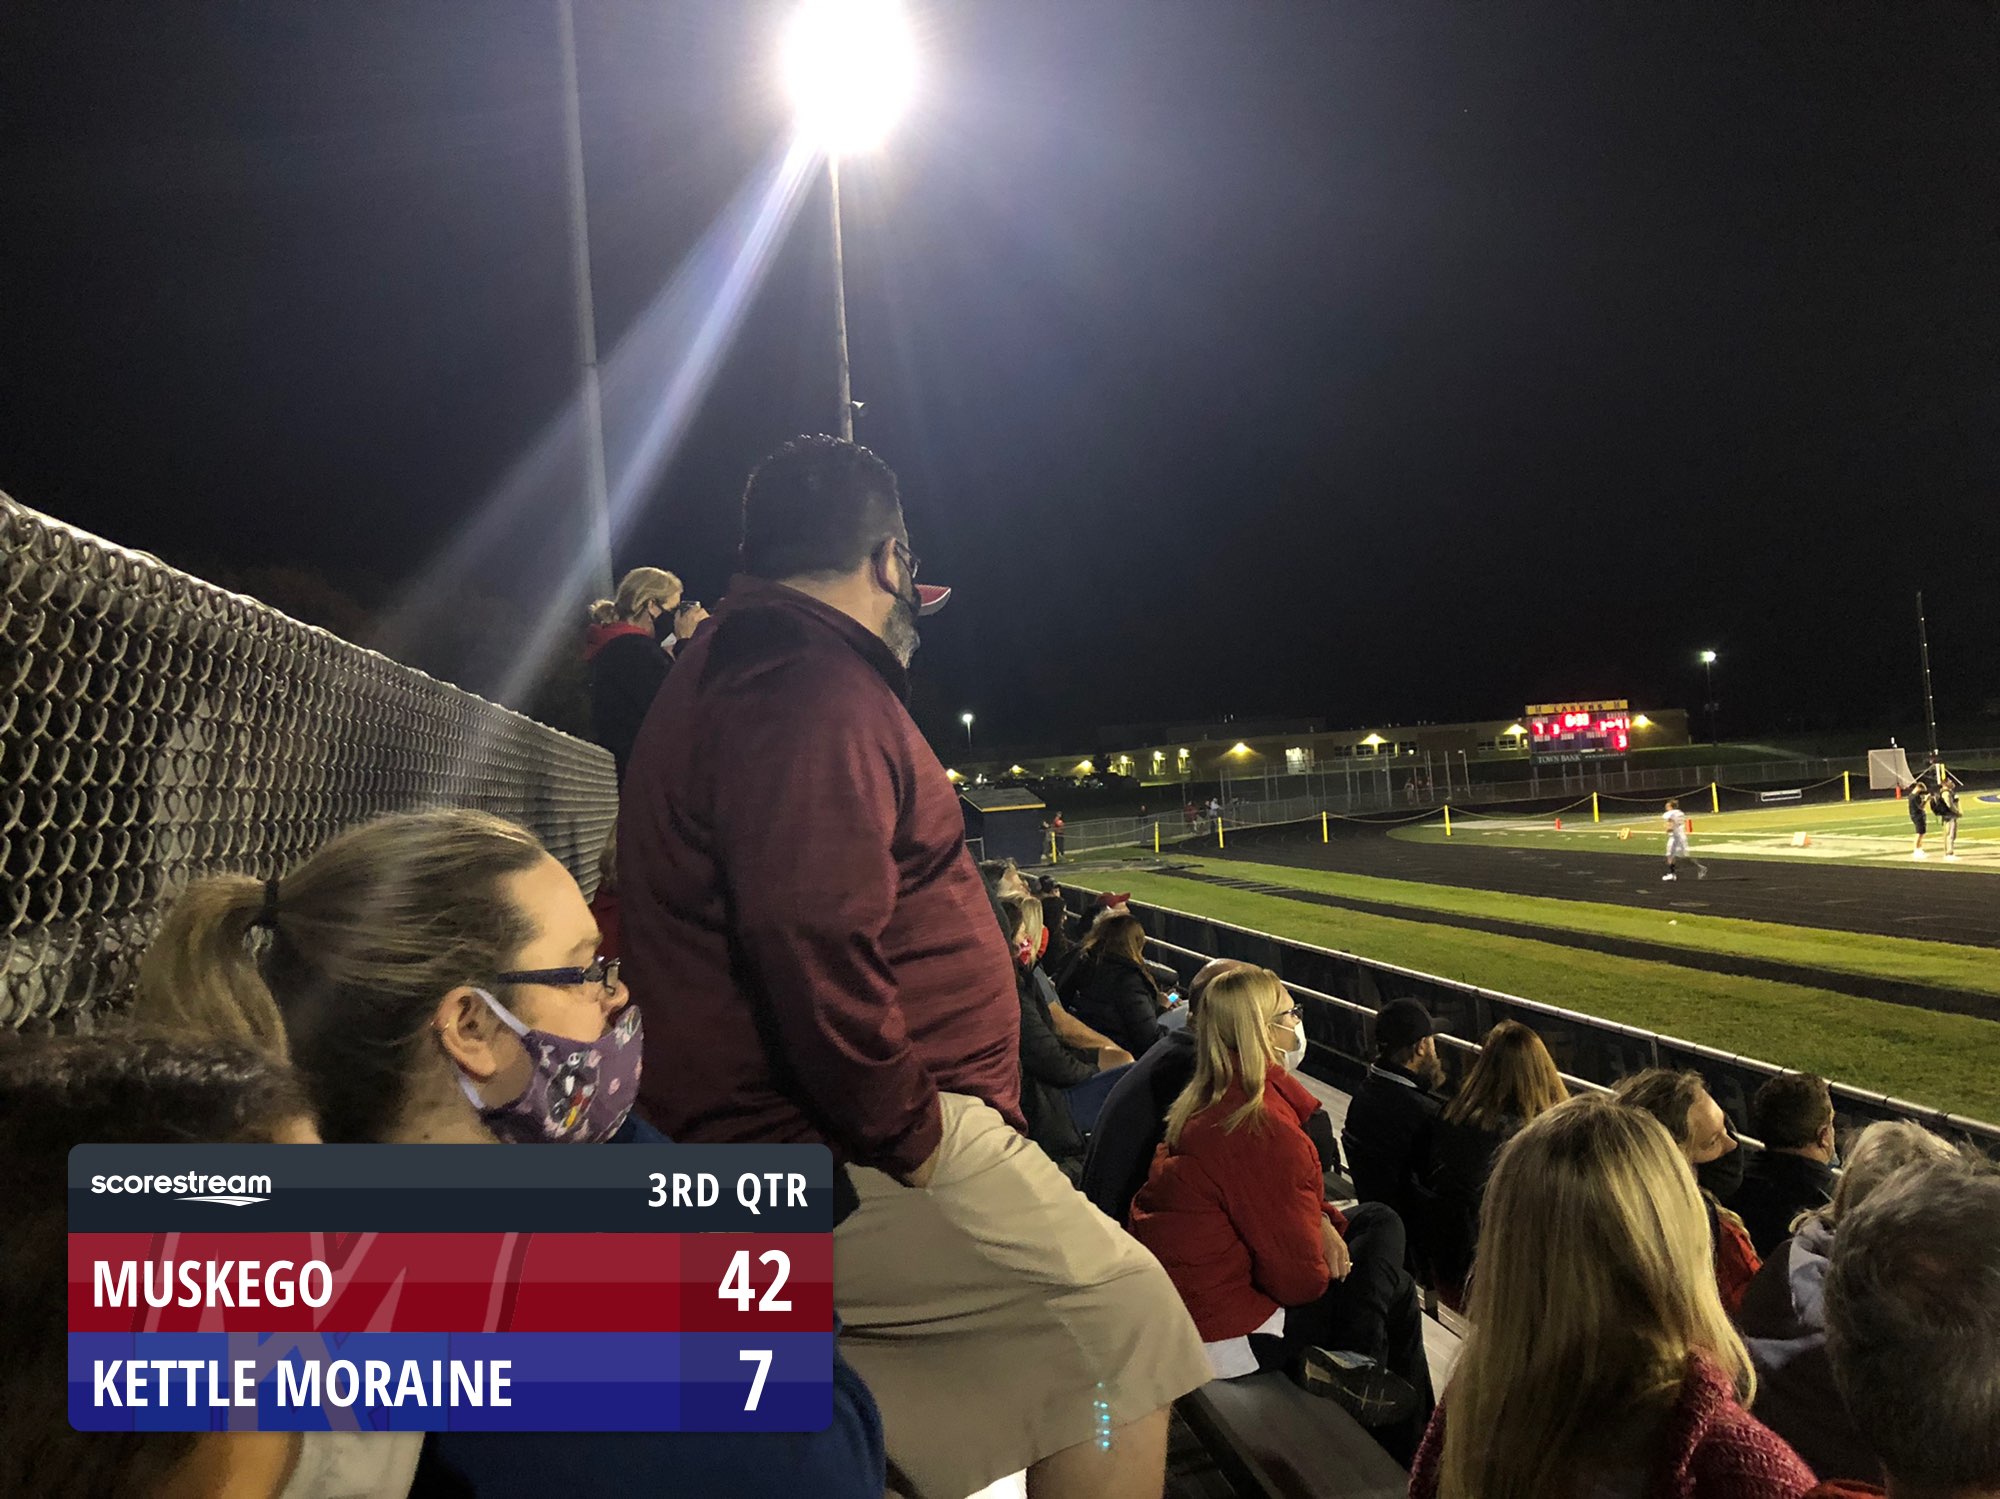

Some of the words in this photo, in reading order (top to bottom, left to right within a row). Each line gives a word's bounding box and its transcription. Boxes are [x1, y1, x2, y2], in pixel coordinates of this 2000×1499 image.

[1553, 703, 1603, 713] LASERS
[1537, 755, 1559, 764] TOWN
[1560, 754, 1581, 763] BANK
